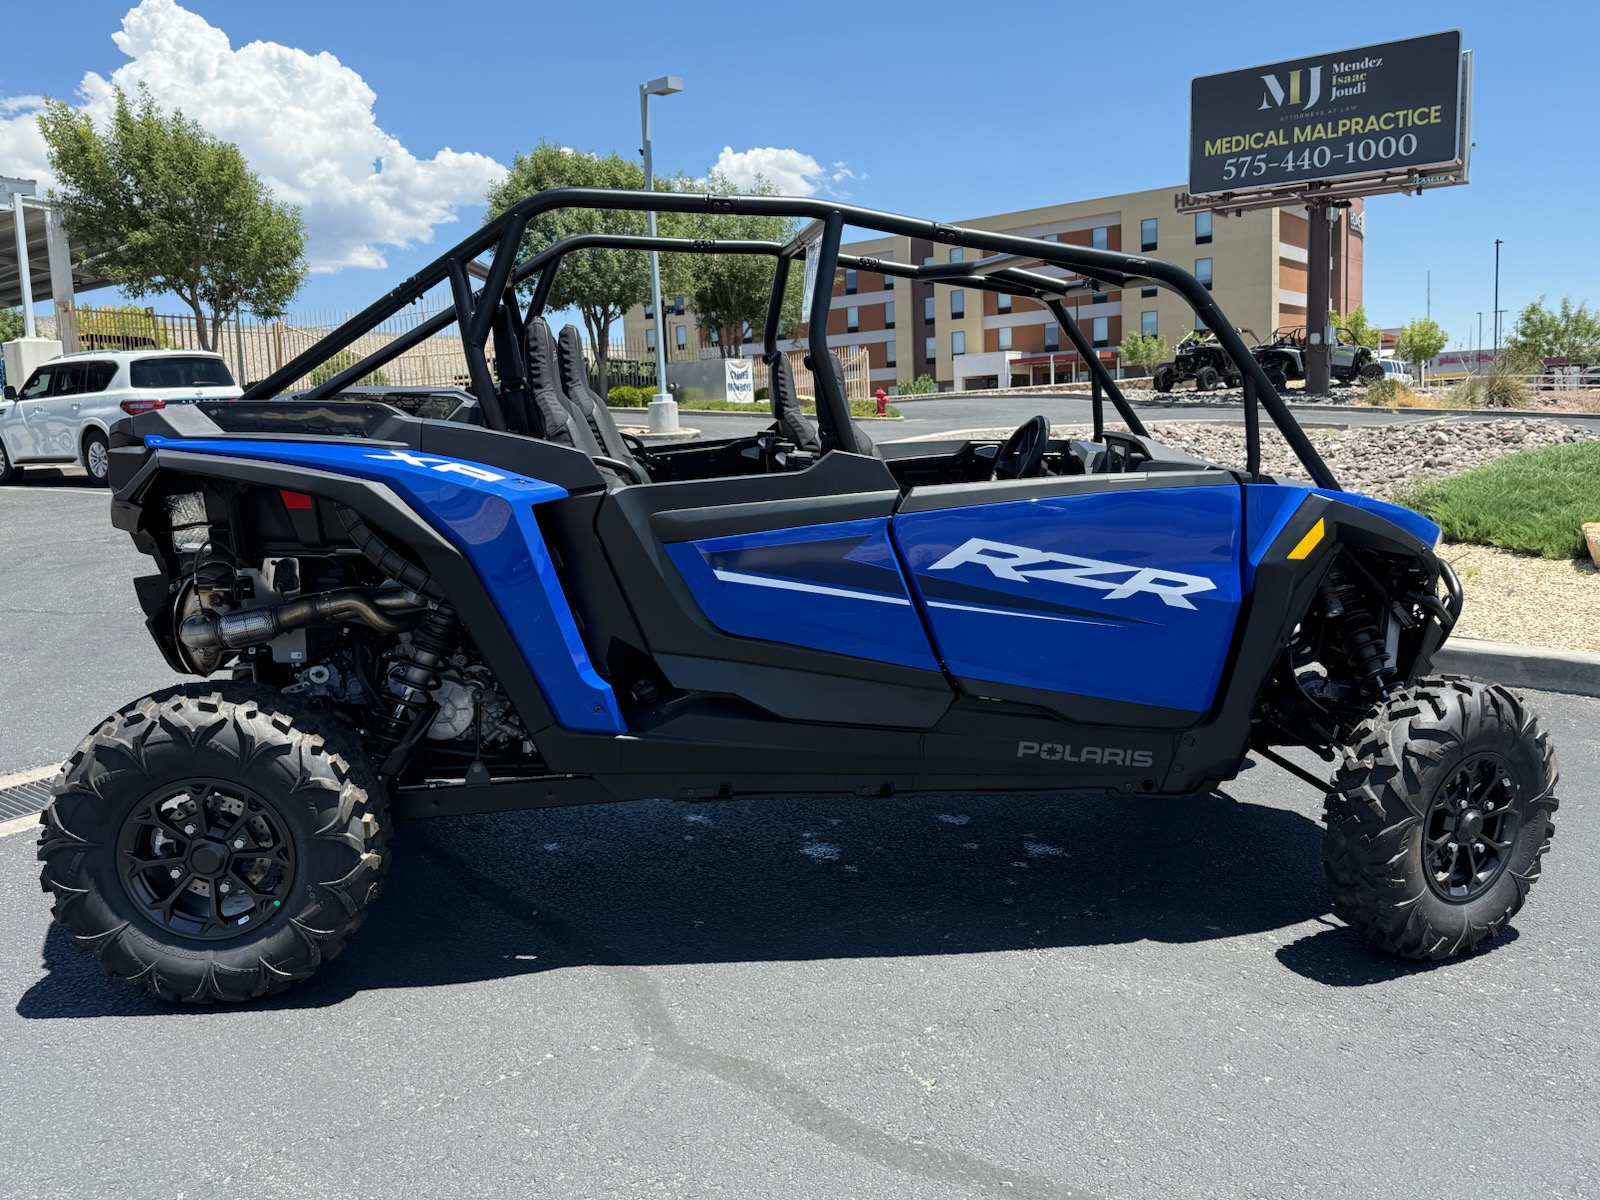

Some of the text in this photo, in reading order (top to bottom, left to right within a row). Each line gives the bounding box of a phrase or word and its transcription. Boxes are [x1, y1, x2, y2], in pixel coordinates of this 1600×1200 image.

[1332, 57, 1383, 75] Mendez
[1332, 72, 1367, 86] Isaac
[1257, 66, 1323, 110] MIJ
[1330, 82, 1366, 102] Joudi
[1280, 104, 1358, 121] ATTORNEYS AT LAW
[1204, 105, 1441, 157] MEDICAL MALPRACTICE
[1222, 133, 1418, 181] 575-440-1000
[362, 450, 507, 482] XP
[927, 537, 1217, 611] RZR
[1017, 740, 1153, 767] POLARIS
